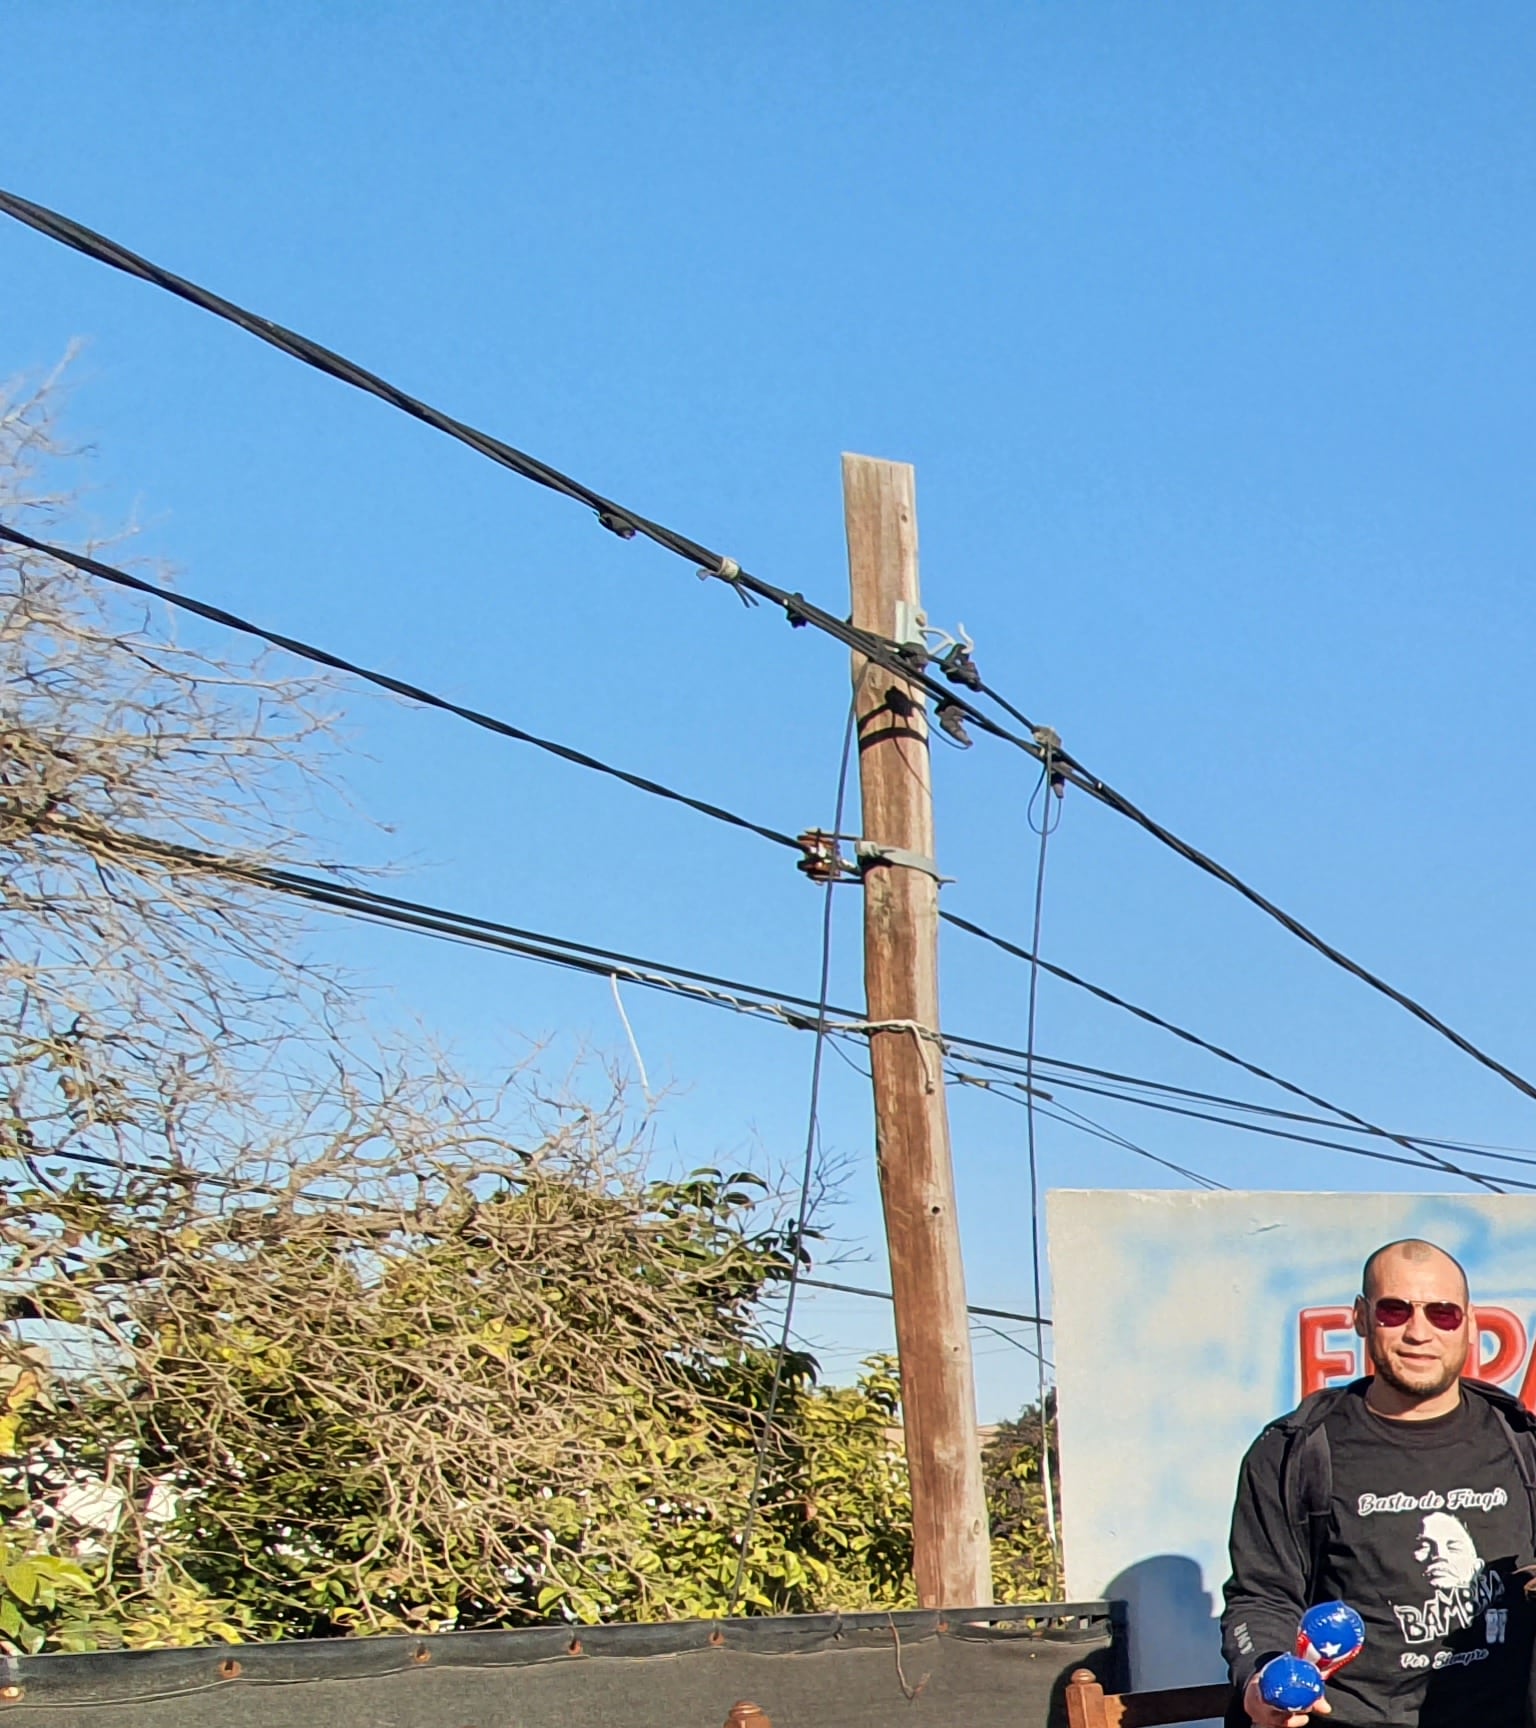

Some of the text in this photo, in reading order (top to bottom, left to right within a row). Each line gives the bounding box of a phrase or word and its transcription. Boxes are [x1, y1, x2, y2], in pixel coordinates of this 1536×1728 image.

[1299, 1306, 1374, 1402] E
[1358, 1491, 1417, 1516] Basta
[1418, 1490, 1446, 1510] de
[1401, 1649, 1489, 1669] Por Siempre
